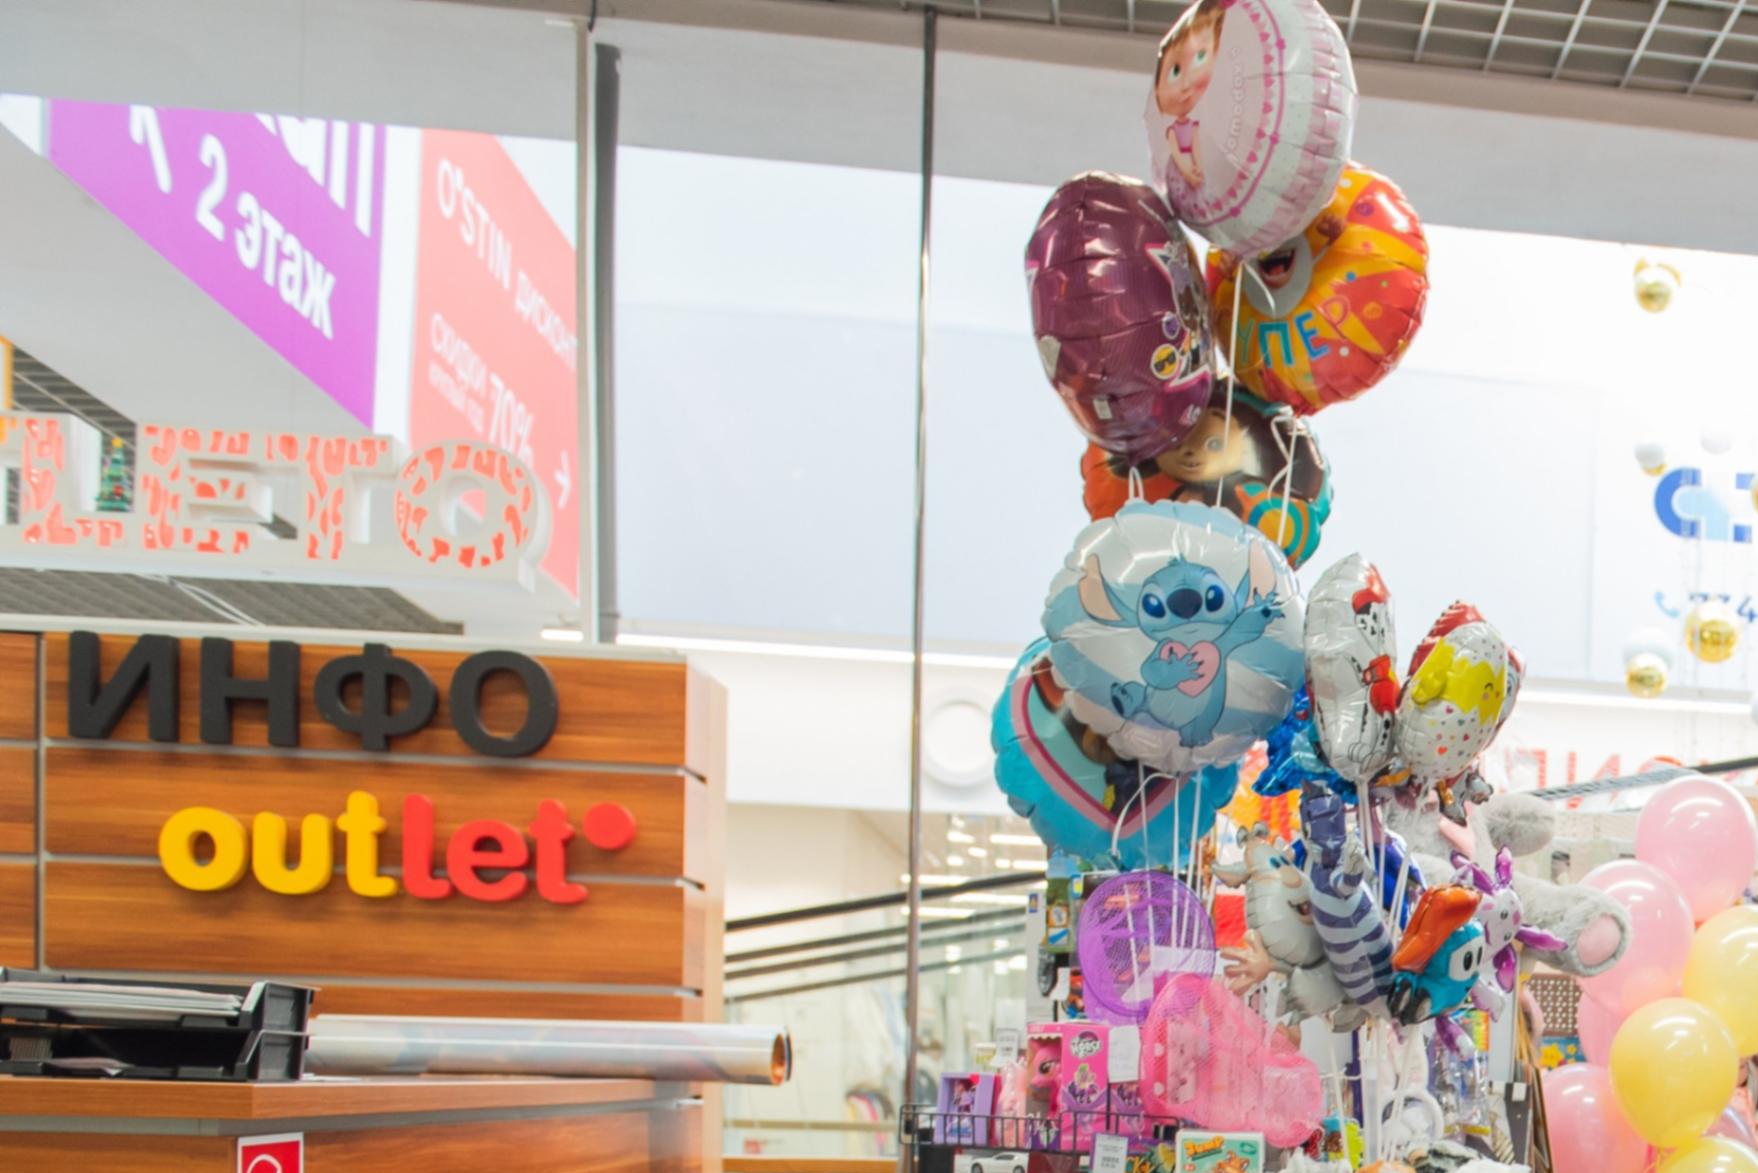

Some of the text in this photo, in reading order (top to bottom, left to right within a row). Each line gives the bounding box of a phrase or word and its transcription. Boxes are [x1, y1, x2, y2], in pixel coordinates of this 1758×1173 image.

[196, 134, 228, 242] 2
[235, 191, 337, 341] этаж
[436, 158, 513, 291] O'STIN
[67, 630, 558, 757] ИНФО
